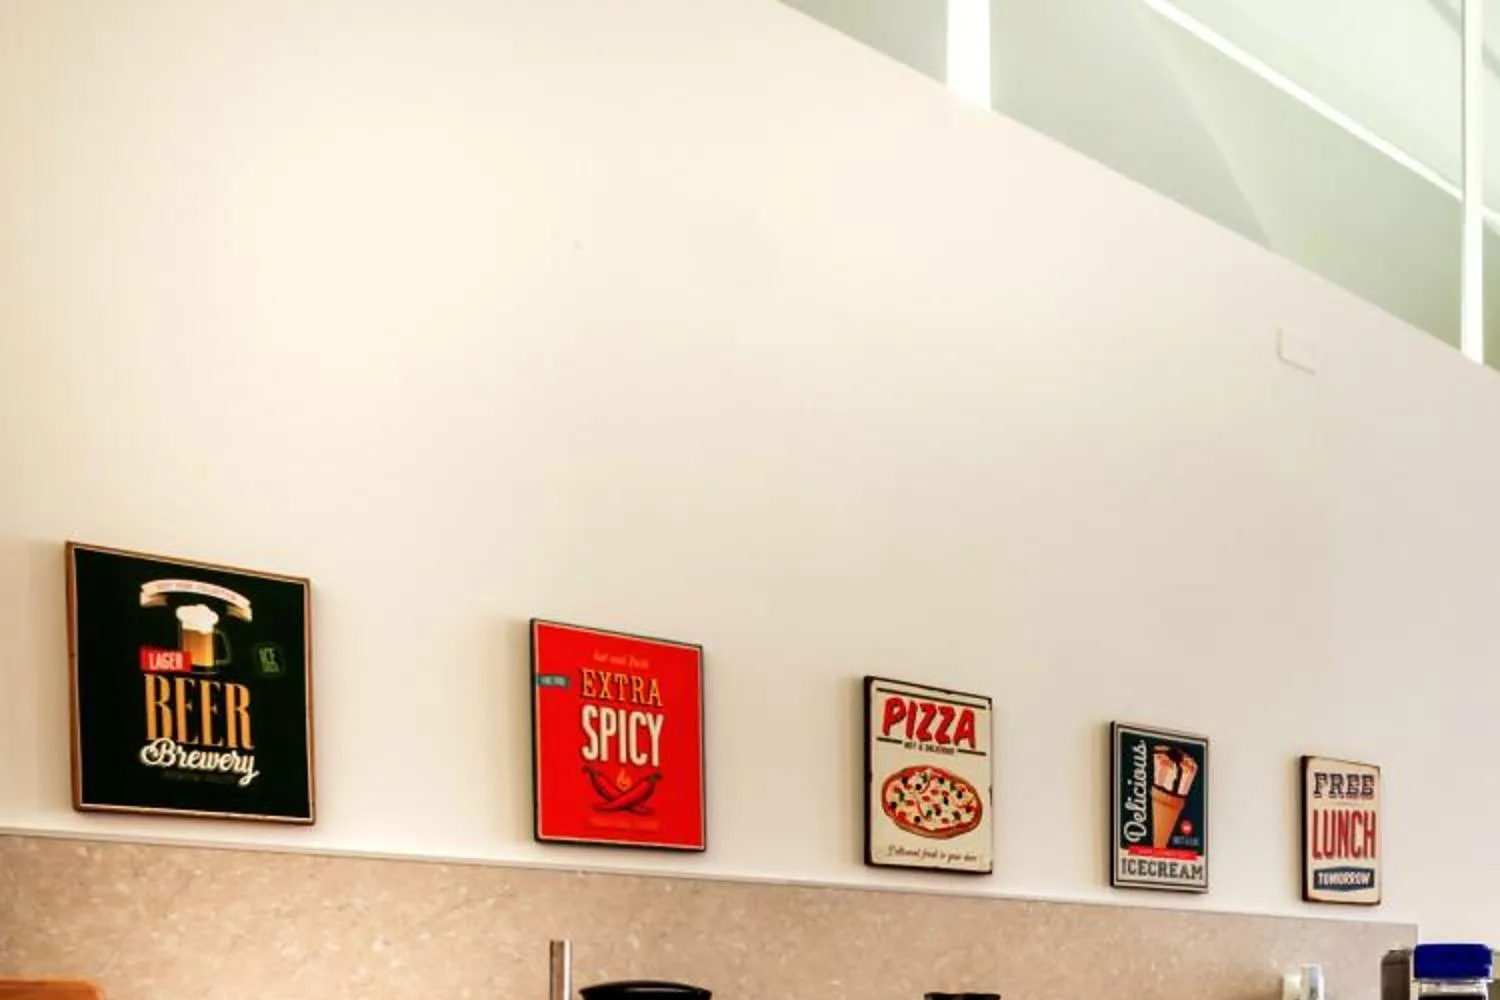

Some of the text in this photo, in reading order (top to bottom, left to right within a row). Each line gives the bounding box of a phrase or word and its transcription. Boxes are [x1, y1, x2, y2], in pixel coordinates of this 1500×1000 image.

[144, 673, 255, 750] BEER
[581, 667, 664, 706] EXTRA
[581, 703, 665, 767] SPICY
[881, 696, 976, 749] PIZZA
[140, 737, 260, 786] Brewery
[1313, 772, 1375, 799] FREE
[1123, 740, 1148, 842] Delicious
[1312, 809, 1376, 860] LUNCH
[1121, 858, 1203, 881] ICECREAM
[1317, 871, 1371, 886] TOMORROW
